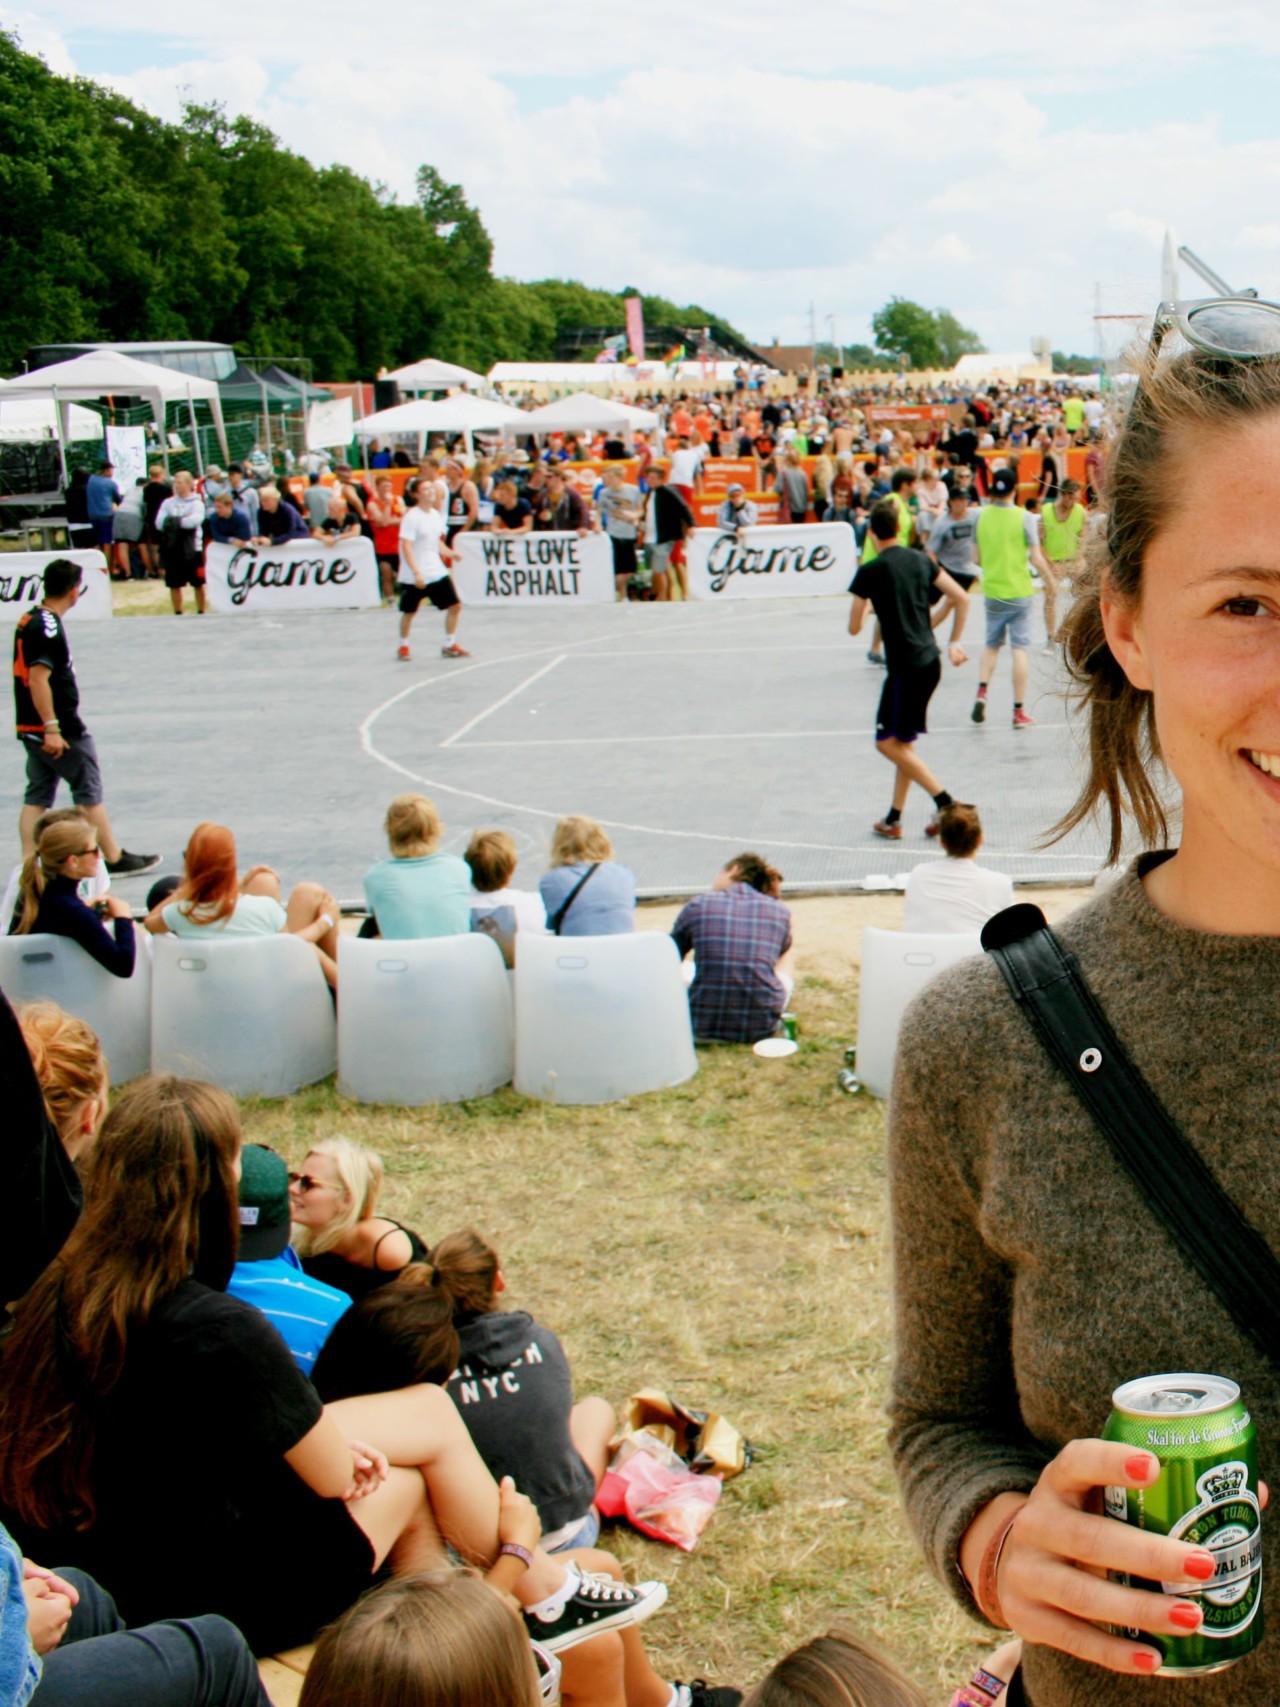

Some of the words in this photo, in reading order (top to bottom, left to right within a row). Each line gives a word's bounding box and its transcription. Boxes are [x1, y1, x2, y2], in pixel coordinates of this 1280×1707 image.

[482, 539, 516, 565] WE
[525, 538, 580, 565] LOVE
[707, 534, 836, 592] Game
[227, 547, 357, 605] Game
[486, 569, 580, 596] ASPHALT
[460, 1371, 520, 1405] NYC
